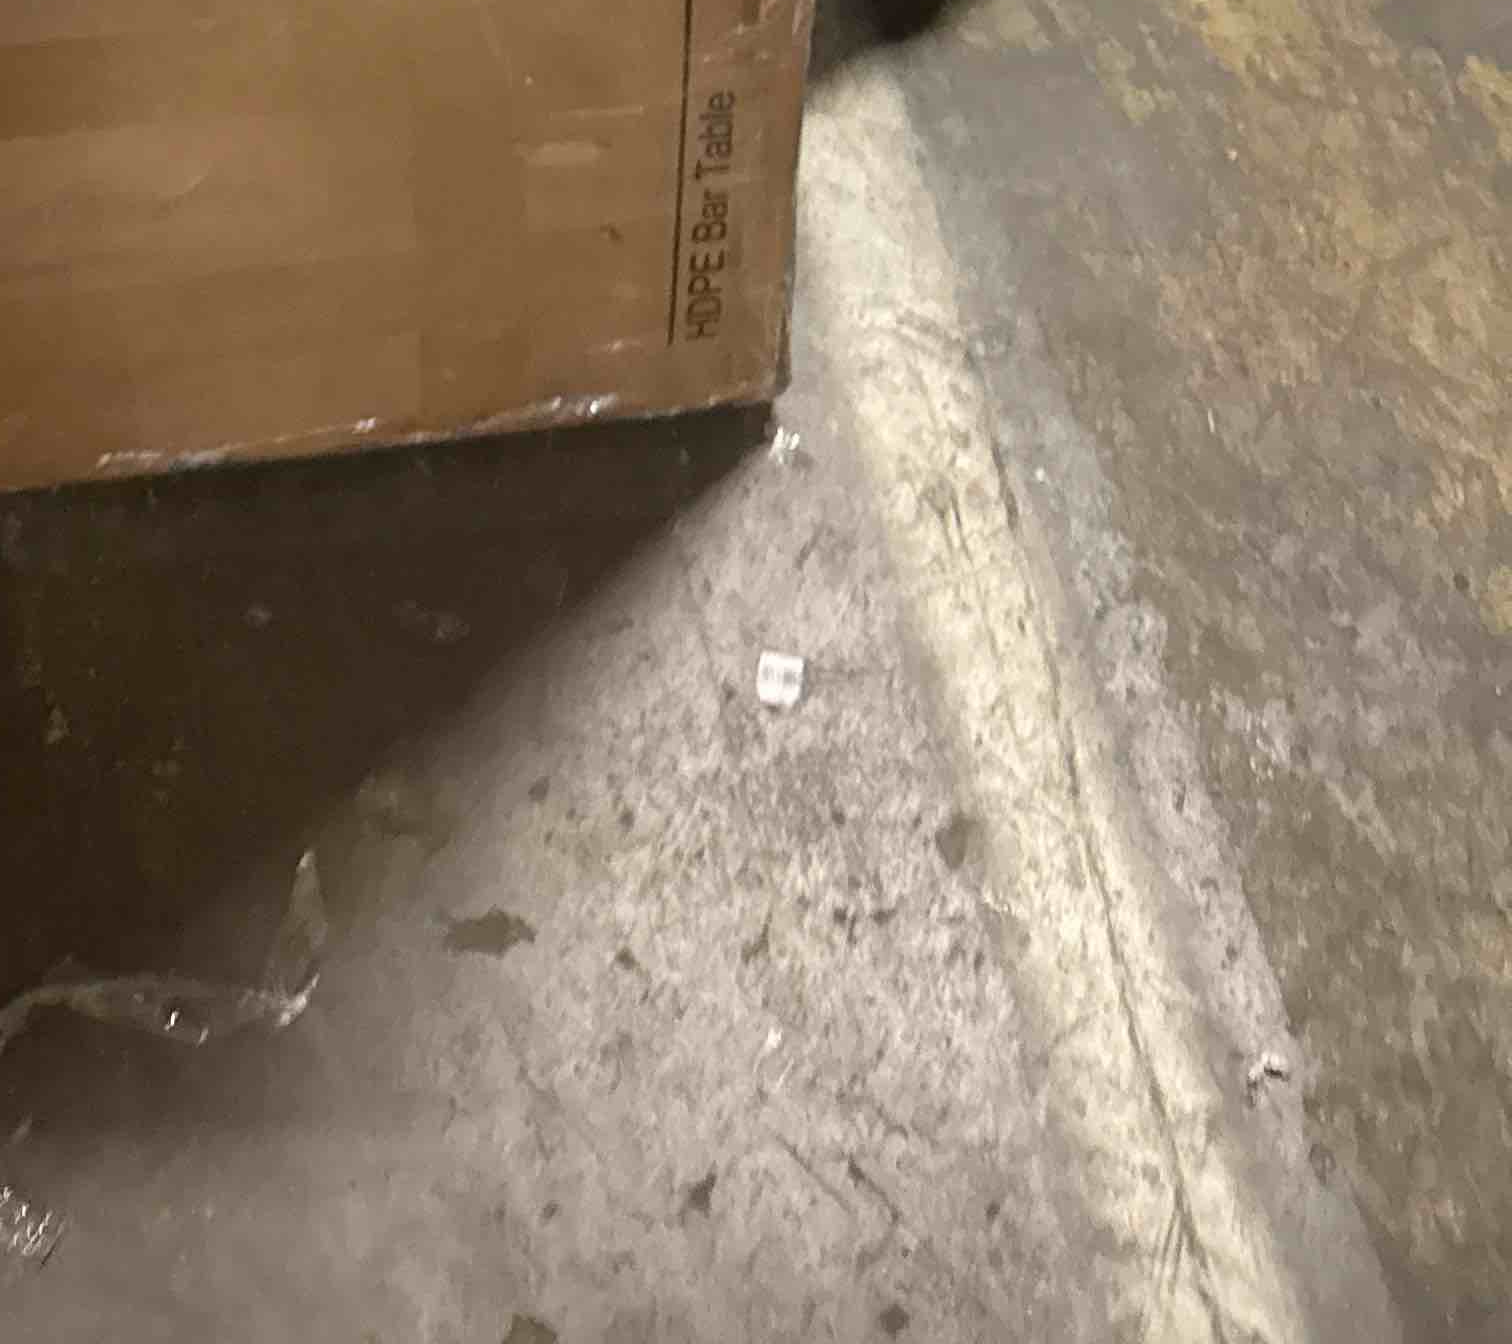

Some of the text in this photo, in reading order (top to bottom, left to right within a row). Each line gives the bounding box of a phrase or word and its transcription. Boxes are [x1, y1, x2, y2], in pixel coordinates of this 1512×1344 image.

[685, 90, 736, 341] HDPE Bar Table
